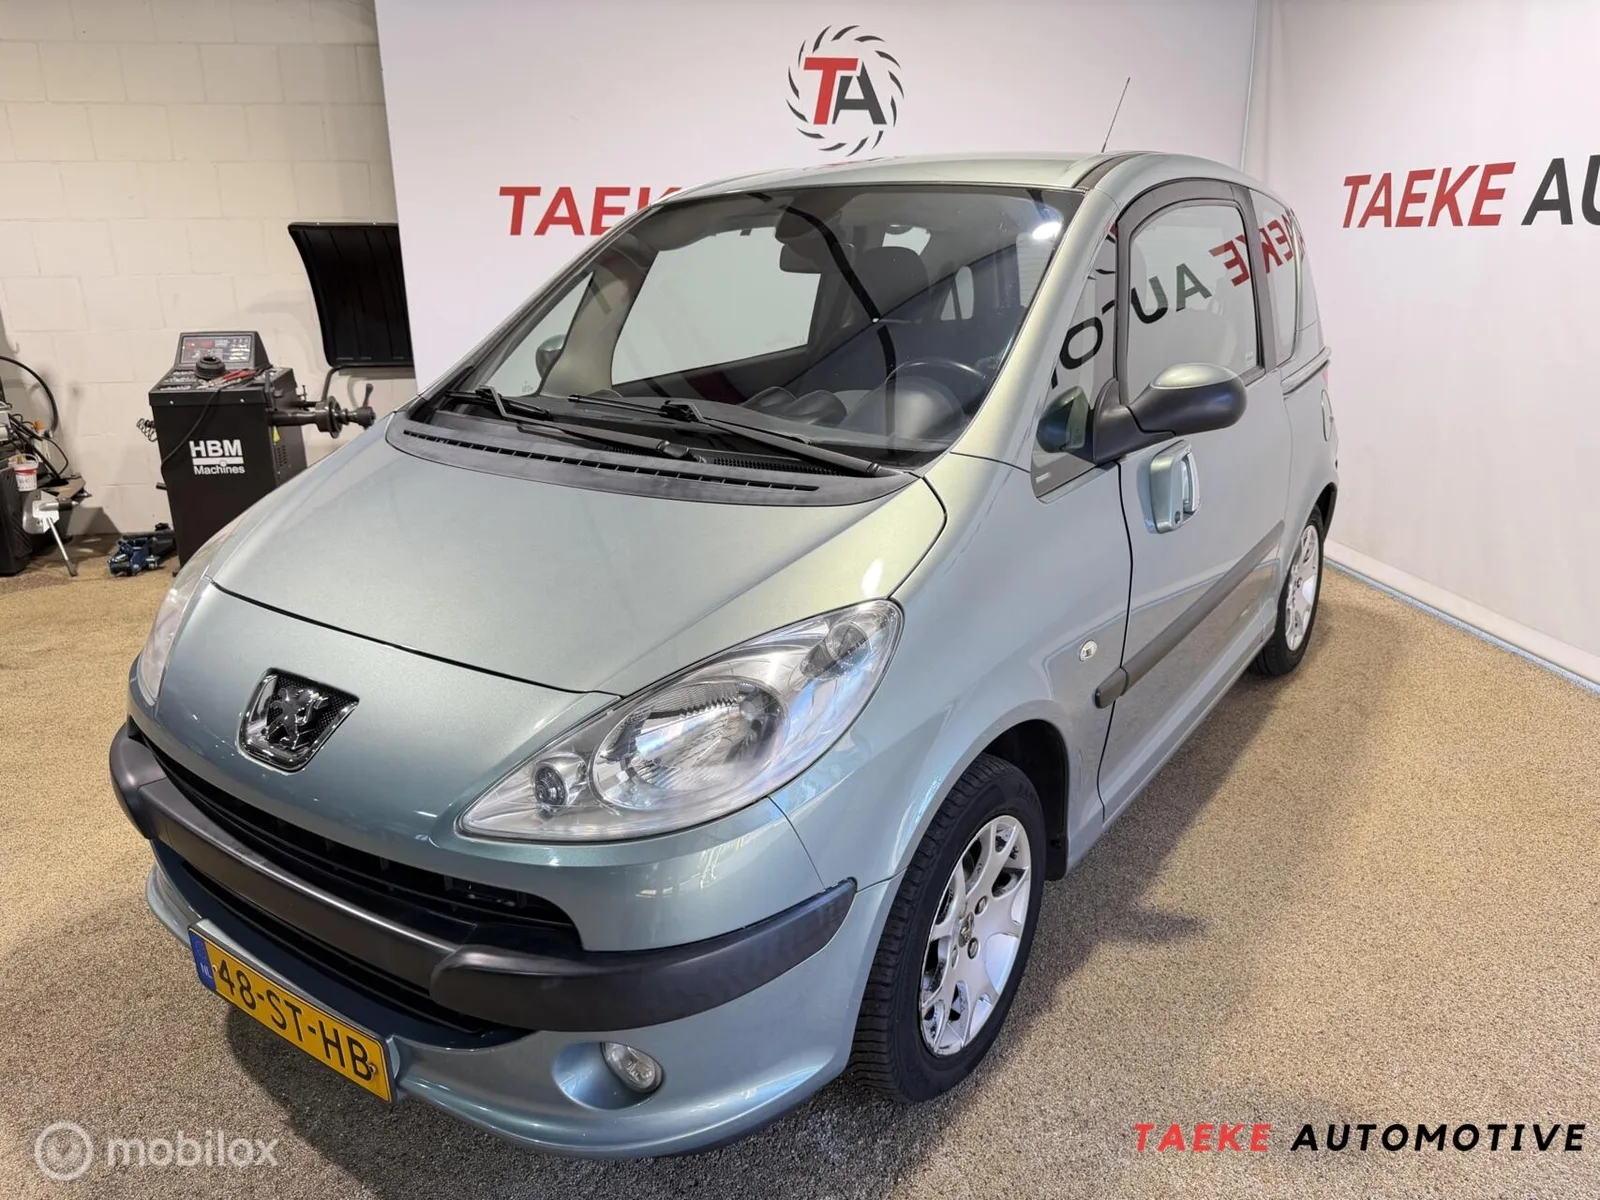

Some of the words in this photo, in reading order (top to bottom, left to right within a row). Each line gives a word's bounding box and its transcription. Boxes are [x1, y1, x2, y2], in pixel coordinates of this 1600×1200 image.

[803, 57, 887, 126] TA
[1343, 161, 1516, 228] TAEKE
[189, 439, 243, 457] HBM
[193, 465, 246, 475] Machines
[218, 959, 374, 1082] 48-ST-HB
